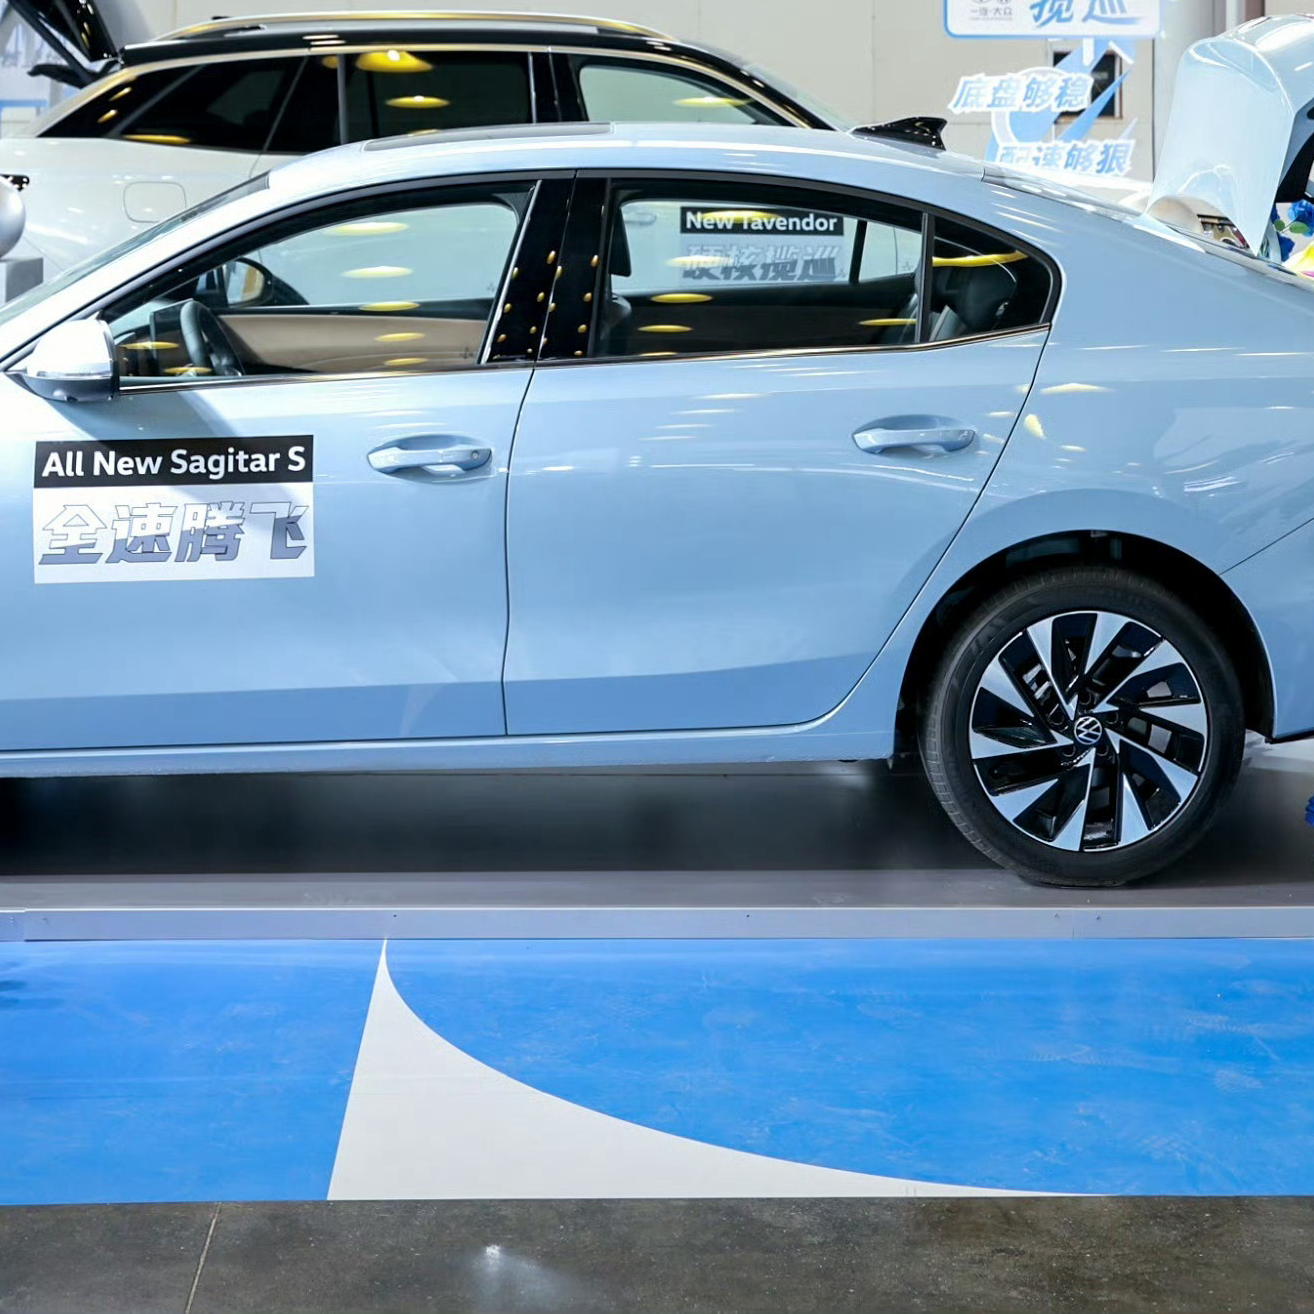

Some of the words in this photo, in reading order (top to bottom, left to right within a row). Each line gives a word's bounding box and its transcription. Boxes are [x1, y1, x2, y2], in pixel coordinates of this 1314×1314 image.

[953, 76, 1089, 109] 底盘够稳
[686, 211, 735, 230] New
[742, 213, 837, 231] Tavendor
[42, 452, 84, 477] All
[93, 450, 163, 476] New
[170, 448, 280, 480] Sagitar
[288, 446, 306, 472] S
[38, 501, 308, 566] 全速腾飞
